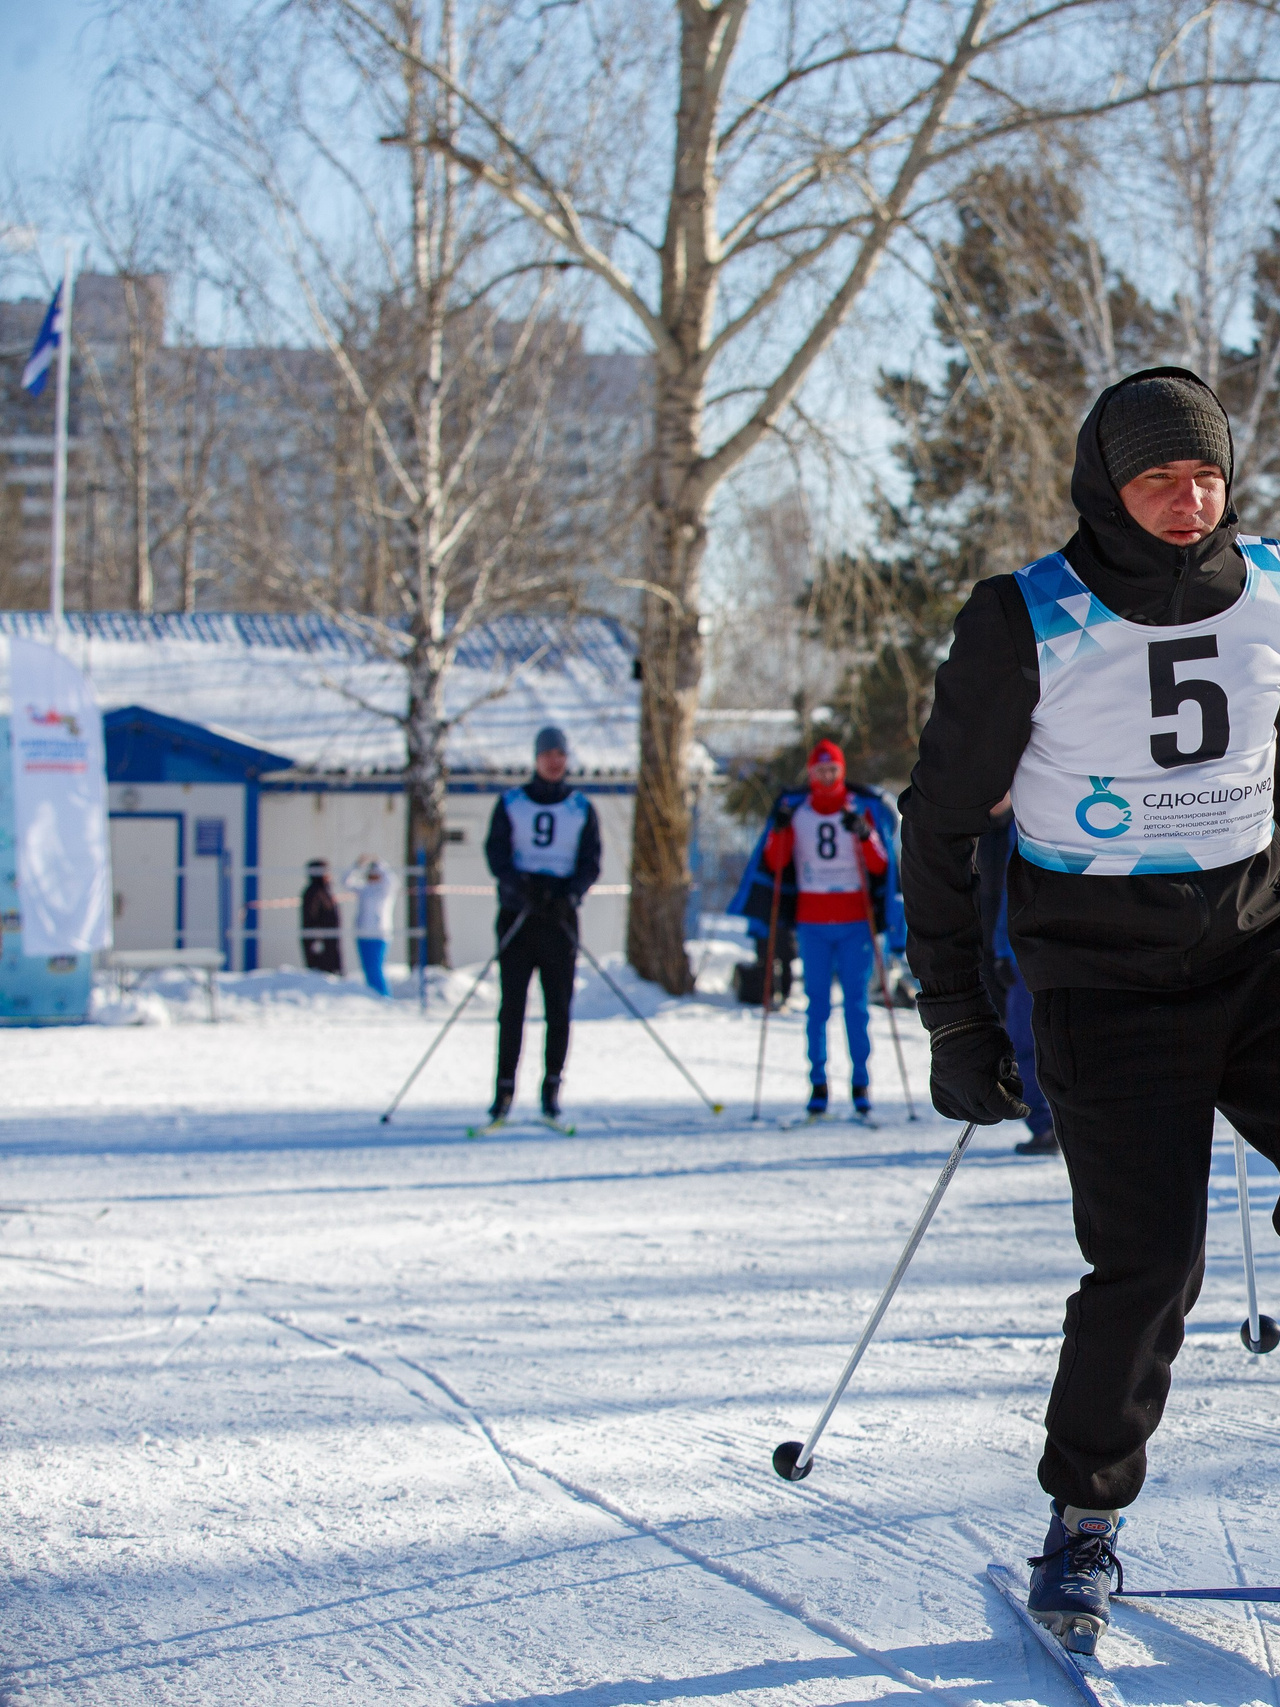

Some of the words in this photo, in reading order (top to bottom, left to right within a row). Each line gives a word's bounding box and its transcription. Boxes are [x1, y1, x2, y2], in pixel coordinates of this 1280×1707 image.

[1147, 634, 1230, 770] 5
[1143, 786, 1252, 809] СДЮСШОР
[1254, 777, 1272, 796] №2
[533, 811, 555, 848] 9
[1143, 810, 1227, 820] Специализированная
[1143, 819, 1218, 830] детско-юношеская
[1219, 813, 1253, 824] спортивная
[817, 822, 837, 861] 8
[1143, 829, 1201, 839] олимпийского
[1201, 827, 1230, 836] резерва
